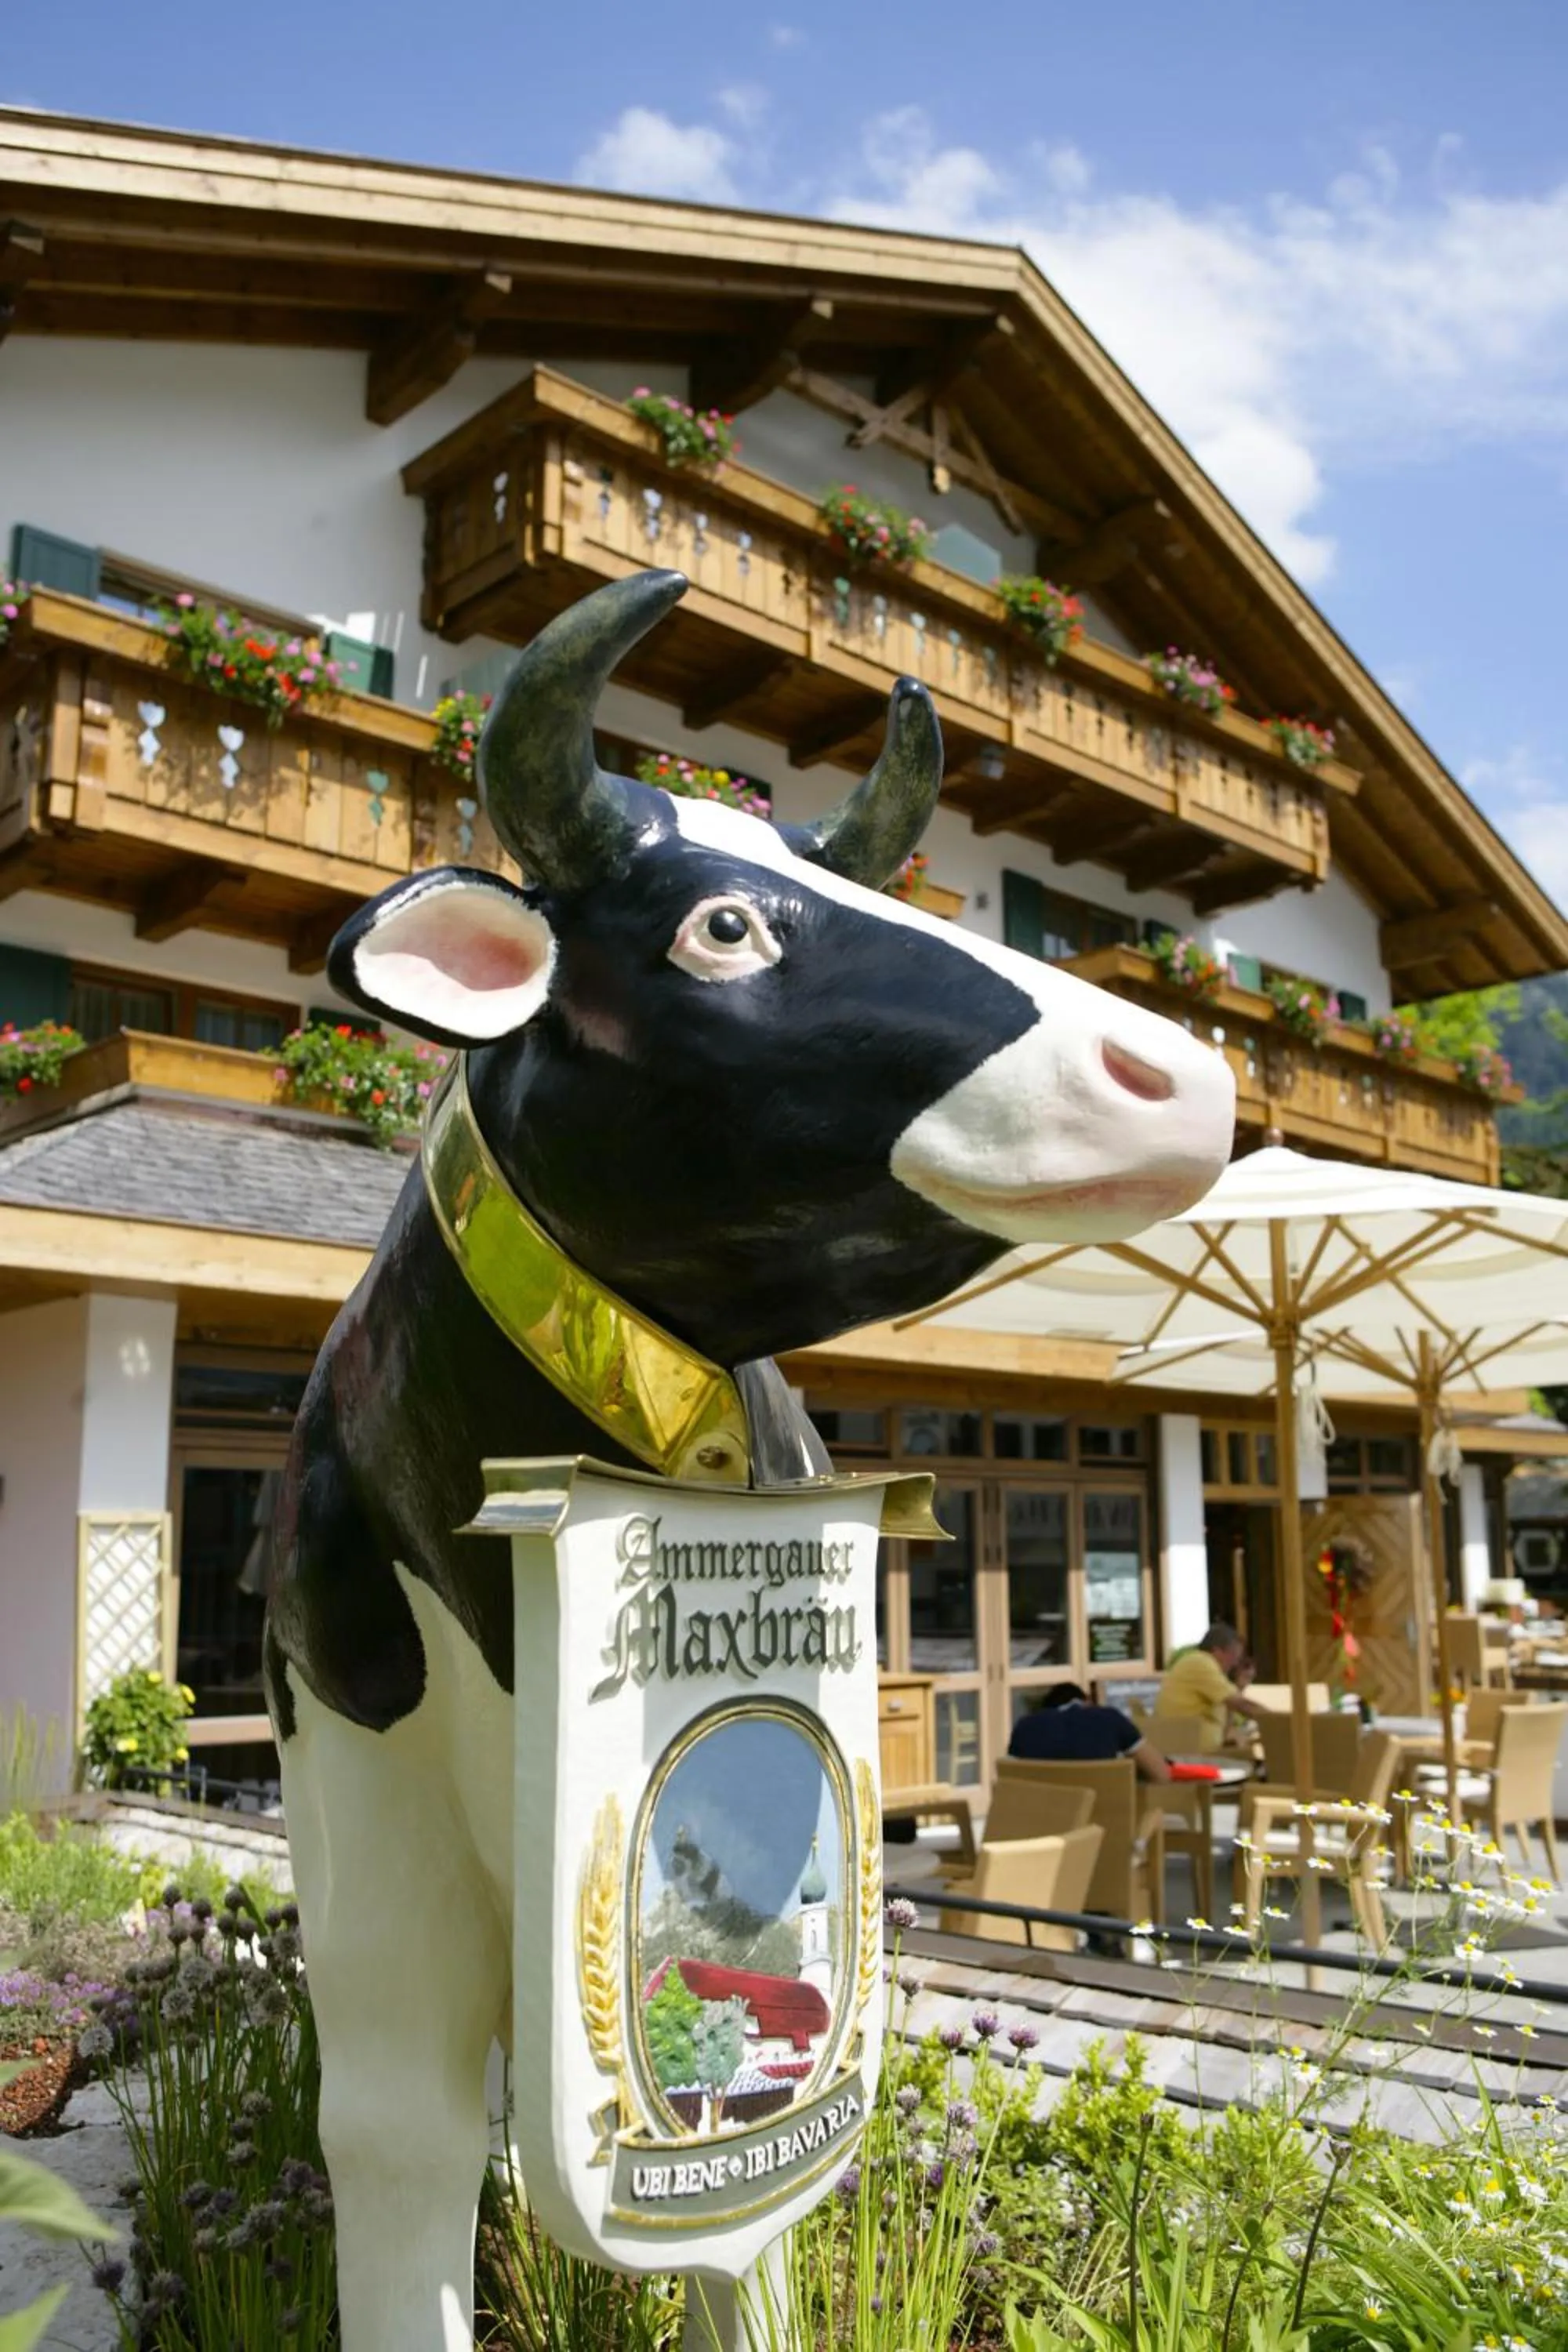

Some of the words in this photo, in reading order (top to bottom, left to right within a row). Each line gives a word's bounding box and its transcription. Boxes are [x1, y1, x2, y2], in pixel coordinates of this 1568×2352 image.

[617, 1514, 855, 1588] Ammergauer
[633, 2166, 672, 2198] UBI
[673, 2155, 728, 2195] BENE
[745, 2141, 775, 2180] IBI
[776, 2094, 860, 2167] BAVARIA
